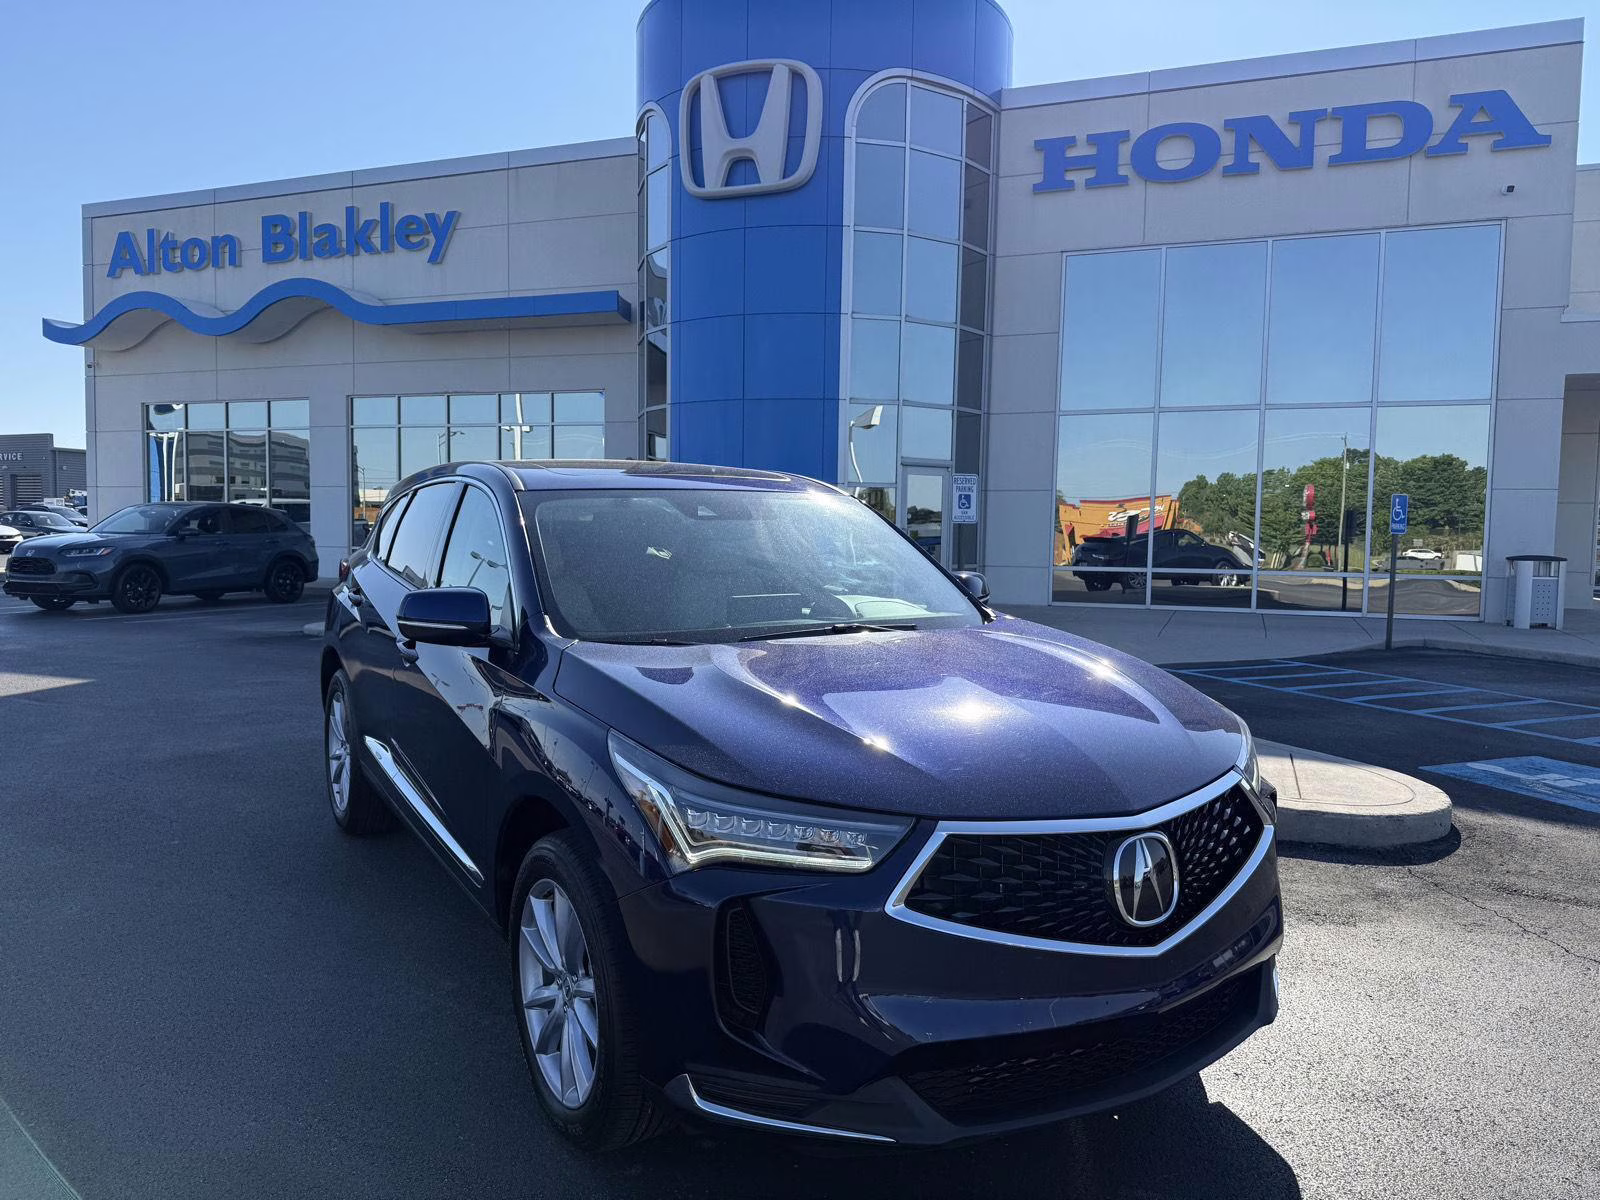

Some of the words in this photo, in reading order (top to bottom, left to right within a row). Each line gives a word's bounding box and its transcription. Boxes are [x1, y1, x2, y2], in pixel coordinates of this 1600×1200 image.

[1032, 89, 1552, 194] HONDA
[107, 228, 242, 278] Alton
[262, 202, 461, 264] Blakley
[953, 477, 976, 485] RESERVED
